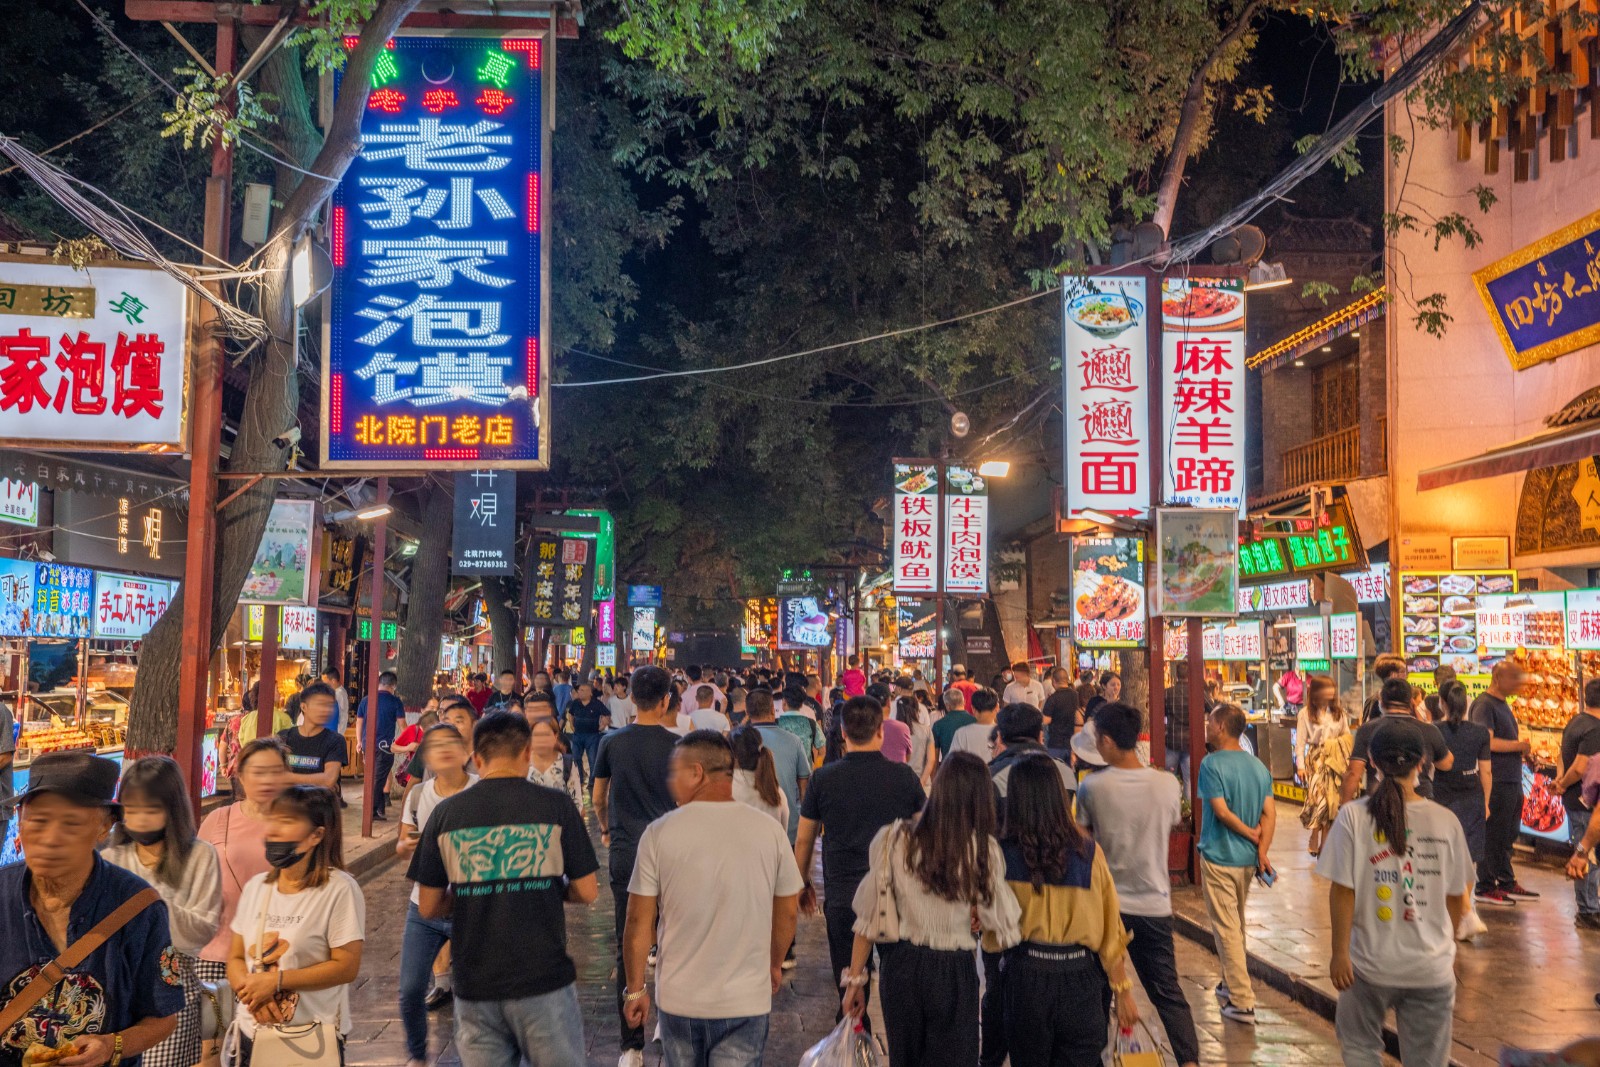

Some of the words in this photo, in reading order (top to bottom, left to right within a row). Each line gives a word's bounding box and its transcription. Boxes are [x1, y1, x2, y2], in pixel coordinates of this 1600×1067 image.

[369, 90, 514, 114] 老字号
[354, 118, 516, 407] 老孙家泡馍
[0, 327, 164, 419] 家泡馍
[355, 416, 513, 445] 北院门老店
[1173, 337, 1235, 494] 麻辣羊蹄
[901, 496, 932, 581] 铁板鱿鱼
[950, 497, 983, 579] 牛羊肉泡馍
[1288, 526, 1350, 568] 灌汤包子
[464, 550, 503, 558] 北院门180号
[1238, 538, 1283, 576] 肉泡馍
[1, 573, 30, 603] 可乐
[534, 542, 557, 619] 那年麻花
[37, 588, 90, 613] 抖音冰淇淋
[100, 590, 167, 627] 手工风干牛肉
[1077, 621, 1143, 639] 麻辣羊蹄
[1333, 628, 1355, 652] 灌汤包子
[1479, 631, 1523, 644] 全国速递
[456, 887, 470, 897] THE
[496, 884, 504, 893] OF
[507, 883, 521, 892] THE
[524, 879, 551, 890] WORLD
[1374, 870, 1398, 883] 2019
